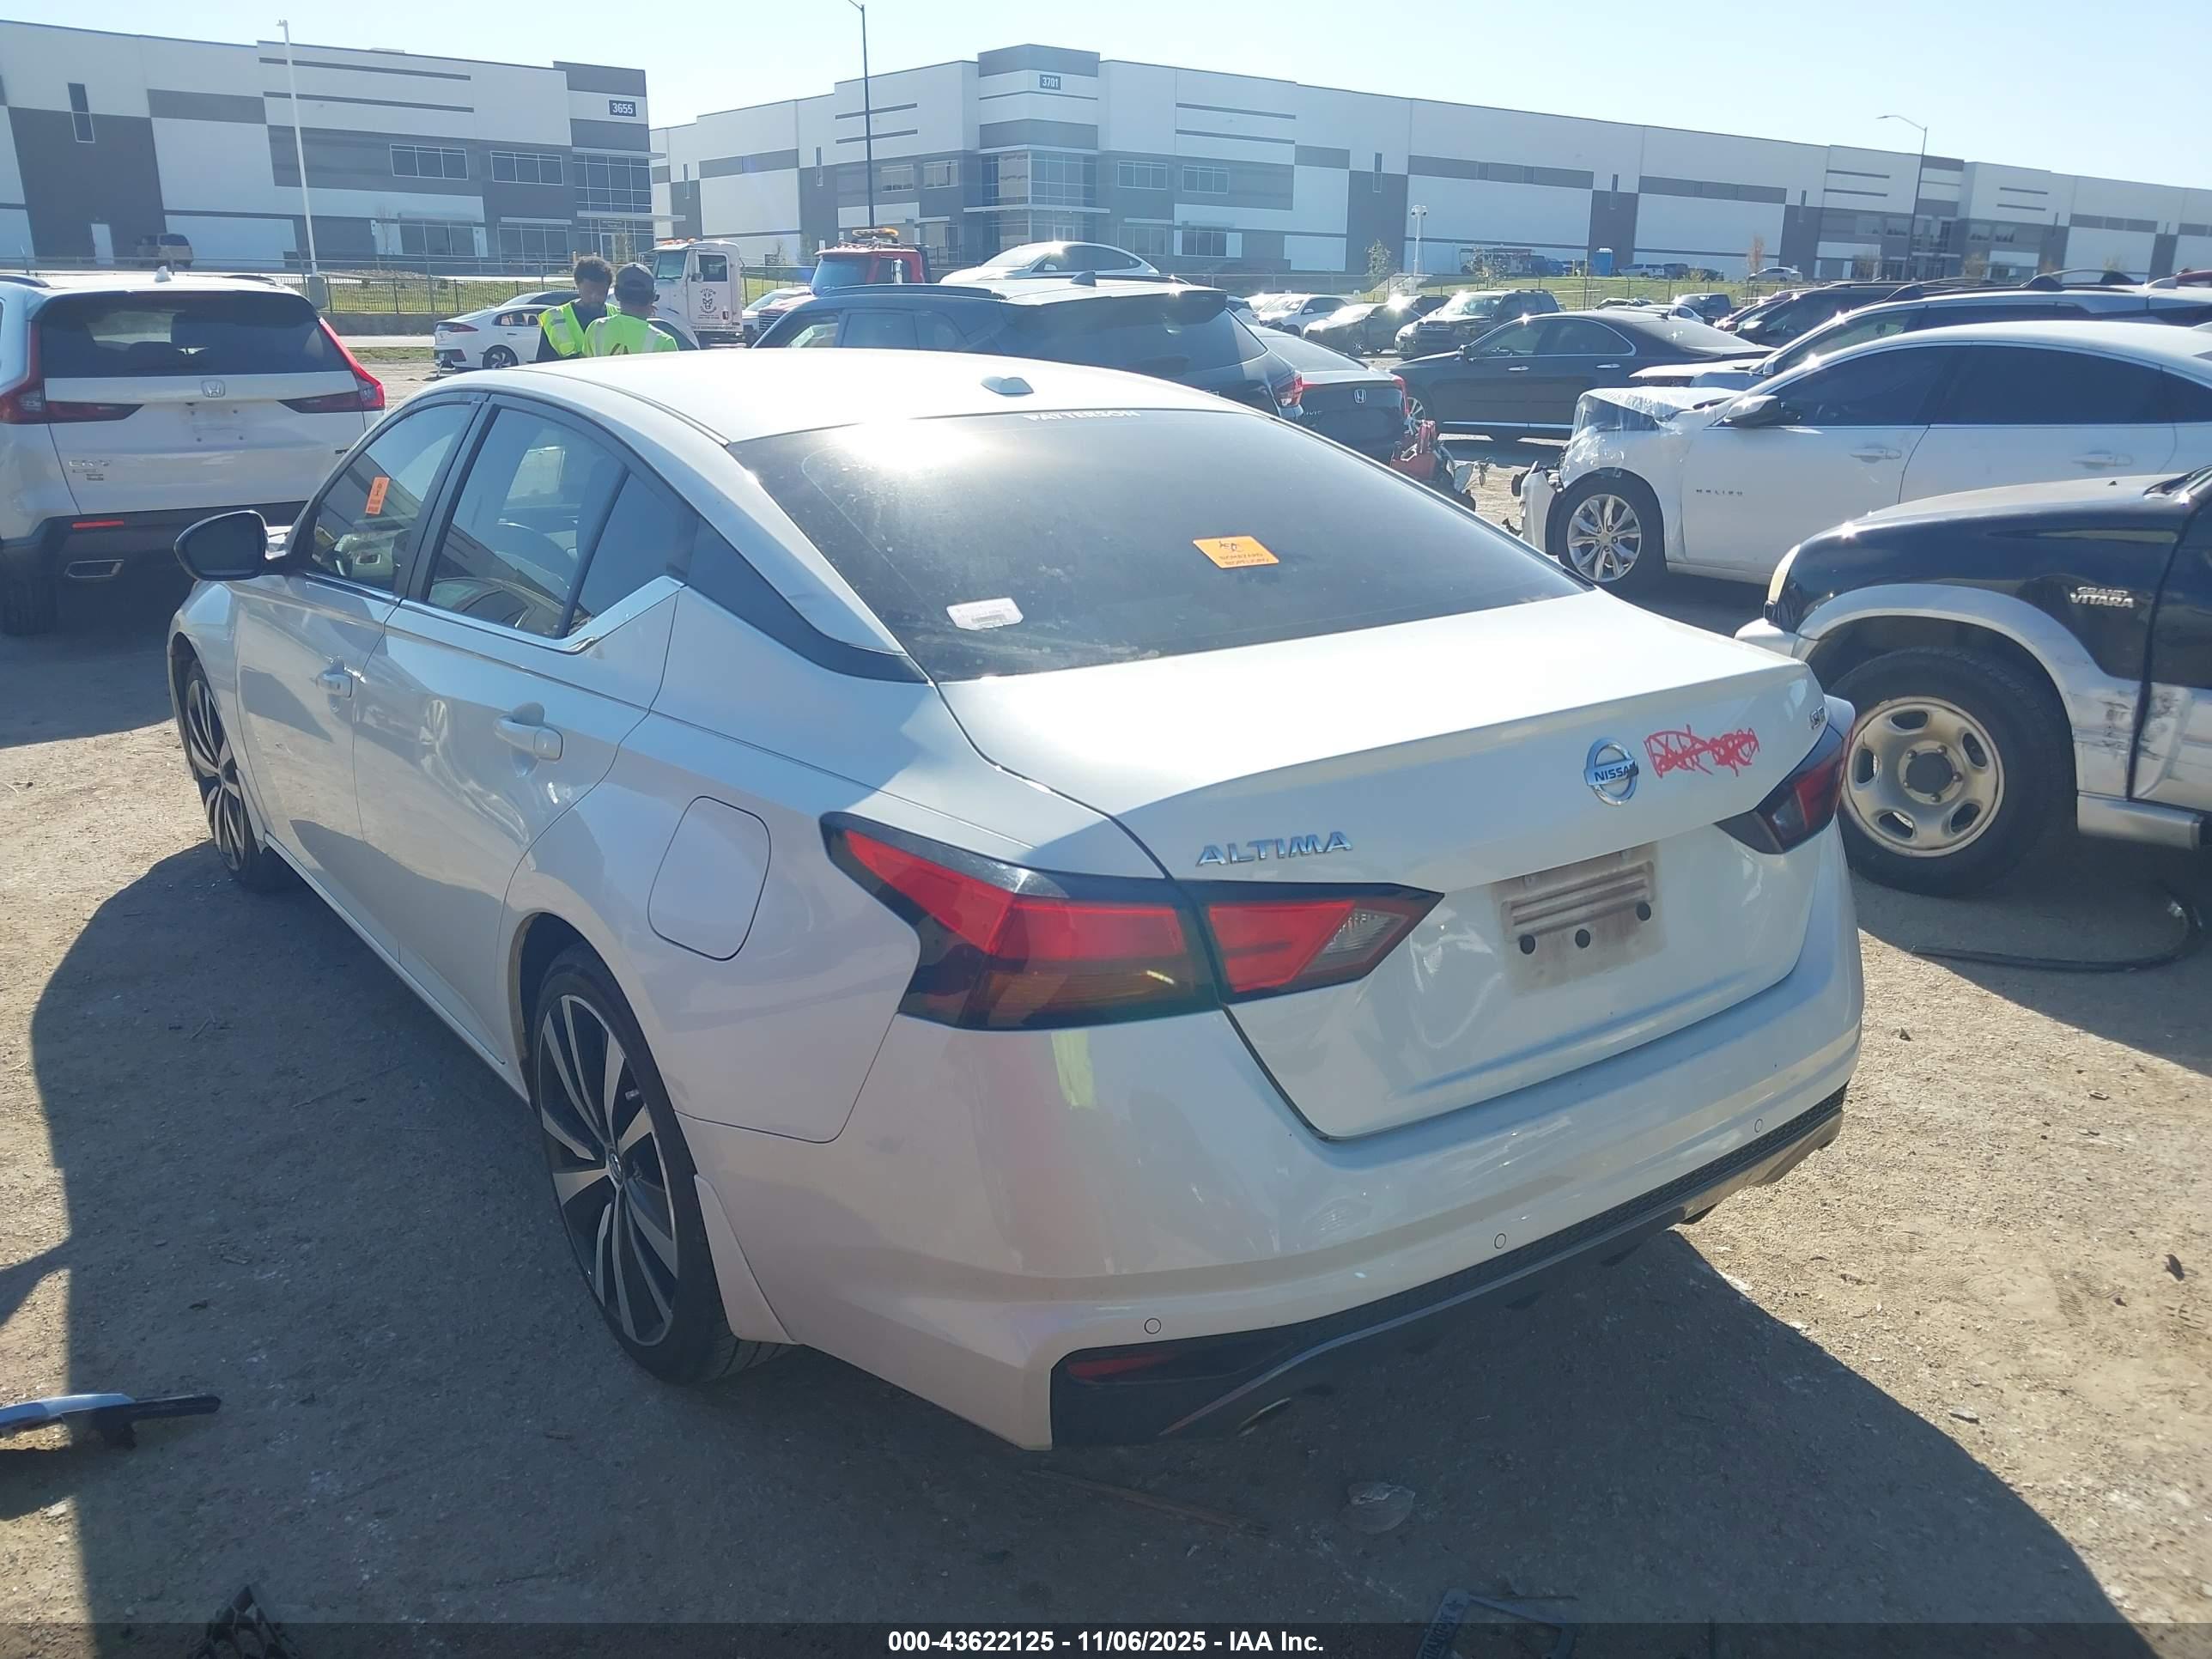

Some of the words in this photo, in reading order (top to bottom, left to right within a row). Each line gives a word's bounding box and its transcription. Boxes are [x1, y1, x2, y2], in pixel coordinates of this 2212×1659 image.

[1042, 76, 1059, 88] 3701
[612, 102, 633, 114] 3655
[2069, 592, 2135, 609] VITARA
[1810, 706, 1827, 730] SR
[1594, 759, 1638, 782] NISSAN
[1195, 830, 1353, 868] ALTIMA
